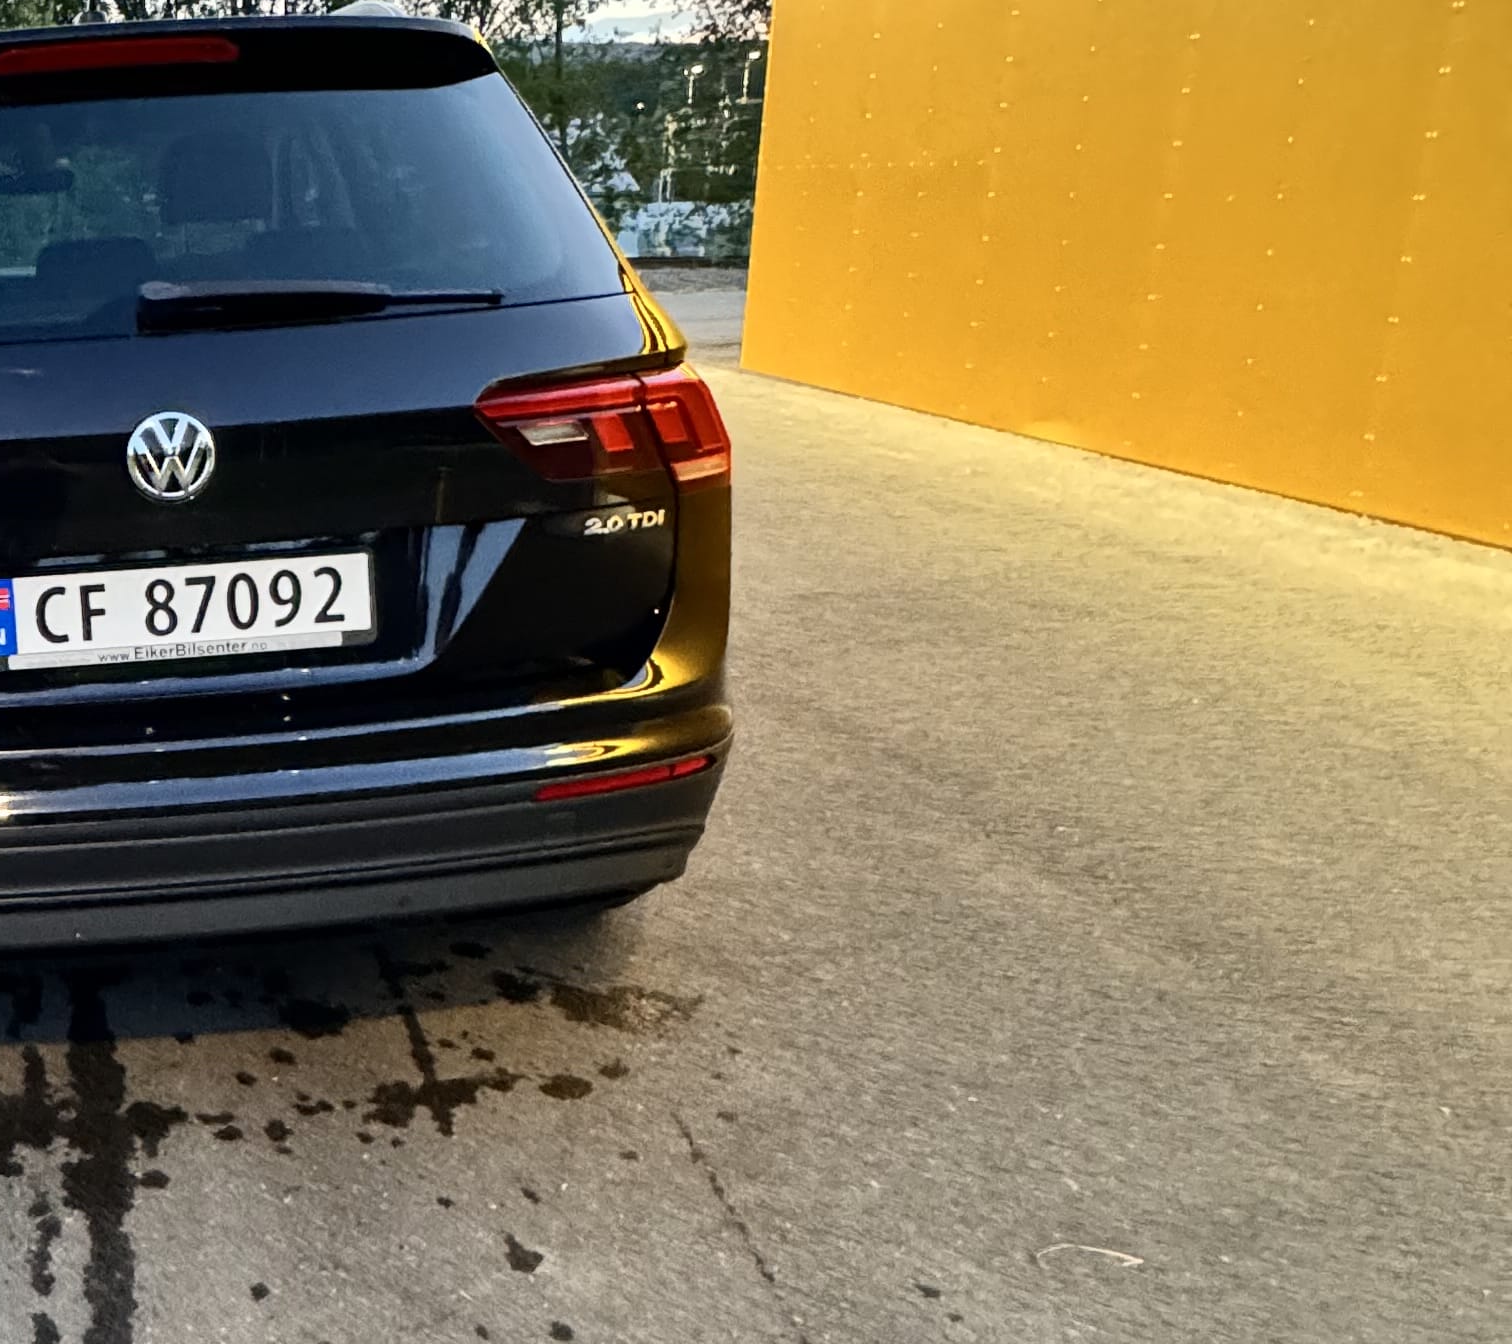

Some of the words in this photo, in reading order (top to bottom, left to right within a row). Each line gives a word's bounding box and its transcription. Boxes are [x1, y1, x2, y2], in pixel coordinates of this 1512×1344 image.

[627, 509, 665, 530] TDI
[35, 585, 106, 644] CF
[144, 566, 345, 636] 87092
